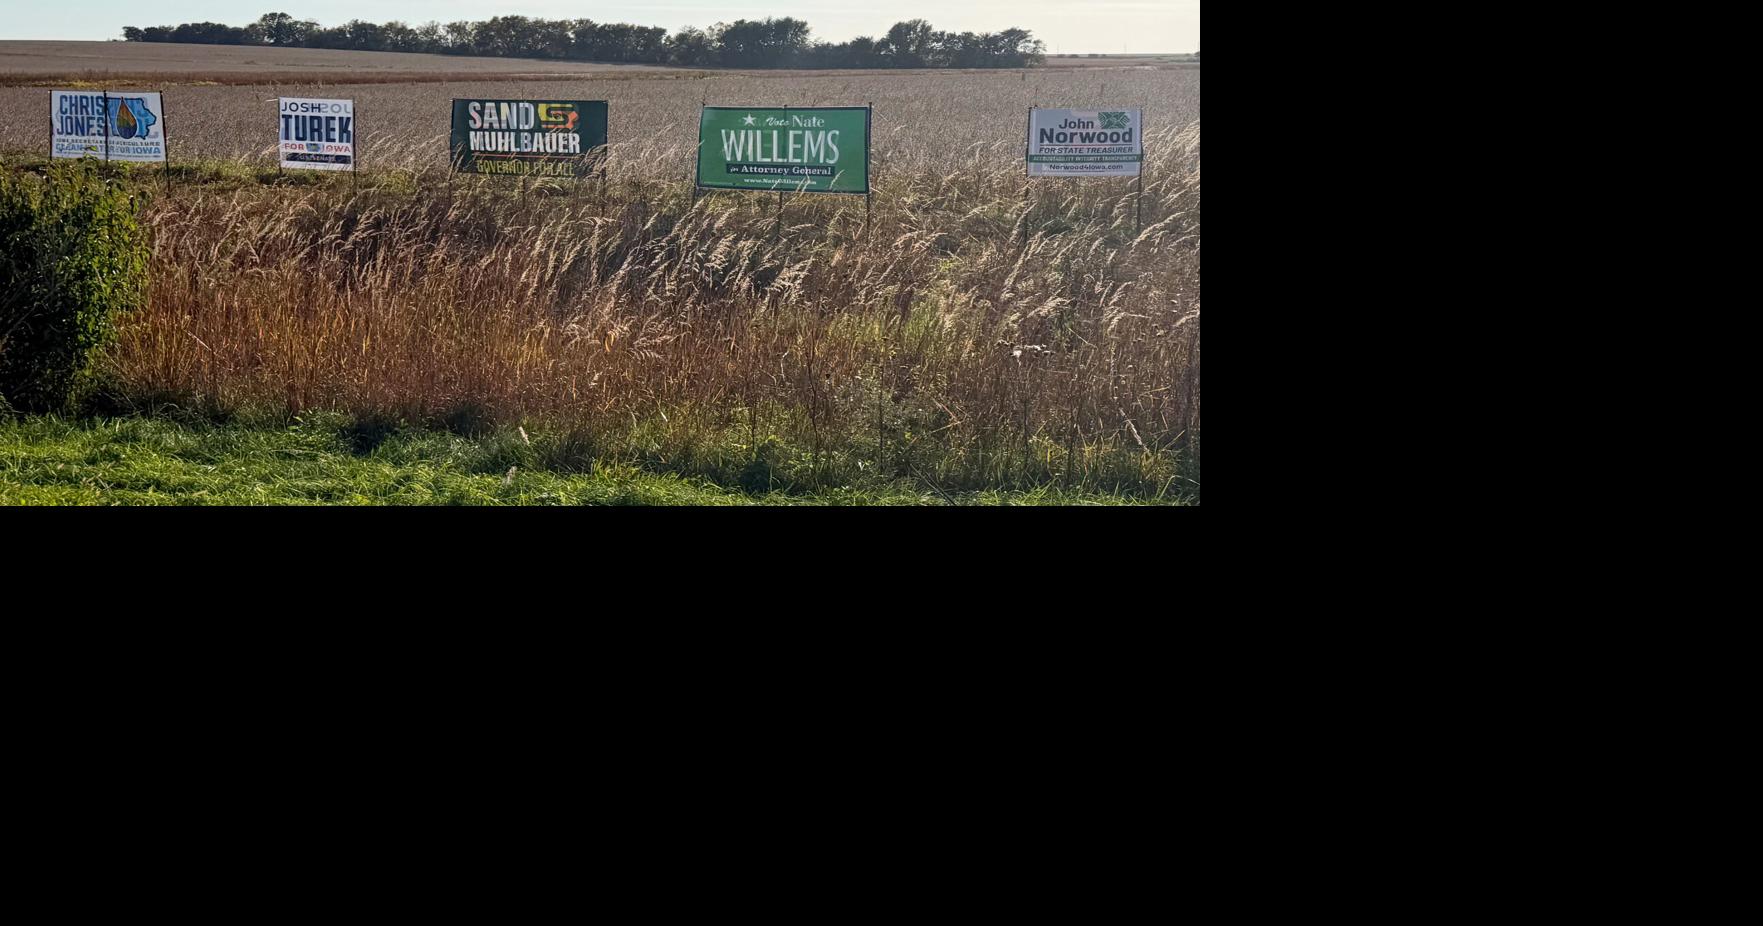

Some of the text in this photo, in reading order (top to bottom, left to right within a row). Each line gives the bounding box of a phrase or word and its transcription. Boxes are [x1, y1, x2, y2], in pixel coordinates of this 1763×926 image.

[60, 95, 105, 115] CHRIS
[282, 102, 321, 113] JOSH
[468, 102, 535, 130] SAND
[766, 115, 825, 128] Vote Nate
[1059, 118, 1094, 129] John
[56, 115, 105, 136] JONES
[281, 114, 351, 143] TUREK
[469, 131, 580, 153] MUHLBAUER
[1040, 128, 1133, 143] Norwood
[132, 146, 161, 154] IOWA
[284, 143, 351, 153] FOR IOWA
[721, 128, 840, 164] WILLEMS
[477, 159, 530, 174] GOVERNOR
[741, 165, 790, 176] Attorney
[792, 166, 831, 175] General
